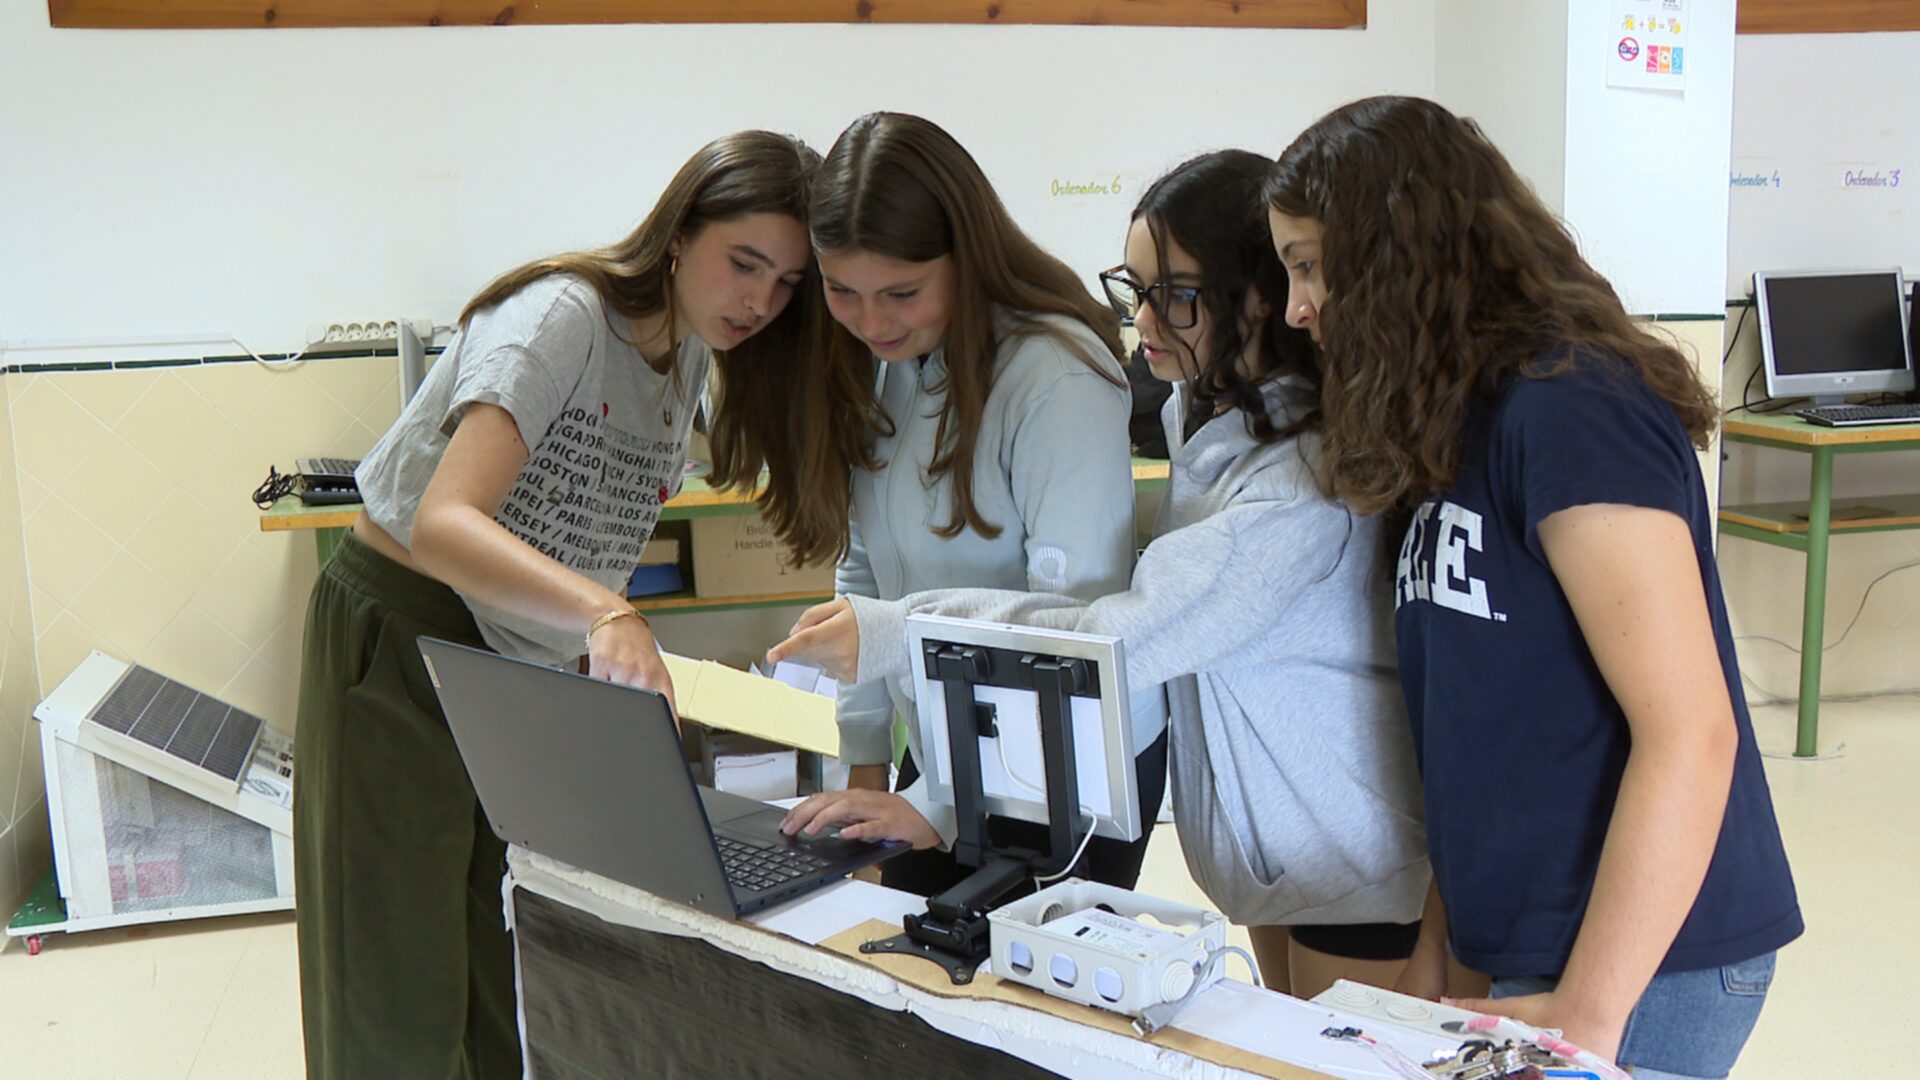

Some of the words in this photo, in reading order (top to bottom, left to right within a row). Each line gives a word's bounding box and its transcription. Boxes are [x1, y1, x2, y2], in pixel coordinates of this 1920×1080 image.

[1051, 178, 1108, 196] Ordenador
[1111, 175, 1121, 193] 6
[1772, 170, 1780, 187] 4
[1844, 170, 1887, 187] Ordenador
[1889, 169, 1901, 187] 3
[555, 509, 593, 531] PARIS
[618, 505, 641, 521] LOS
[735, 539, 774, 551] Handle
[1394, 500, 1492, 620] ALE
